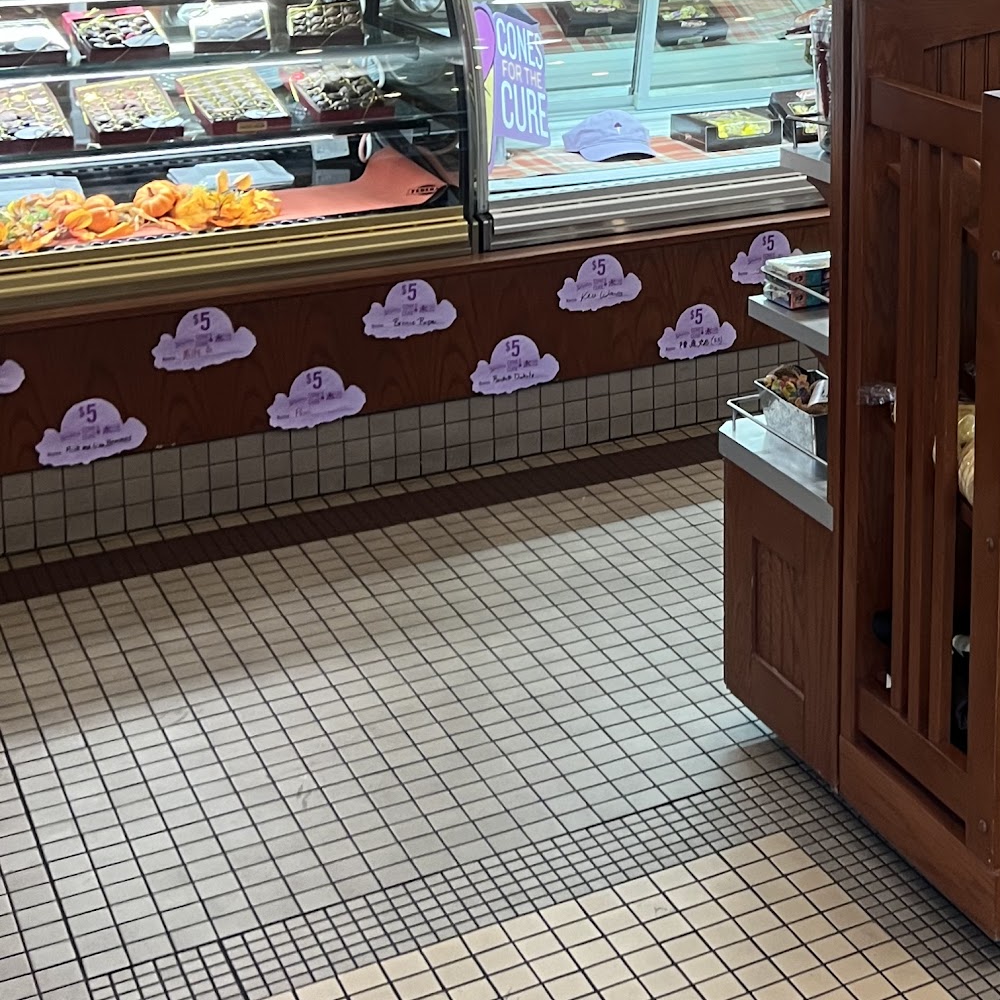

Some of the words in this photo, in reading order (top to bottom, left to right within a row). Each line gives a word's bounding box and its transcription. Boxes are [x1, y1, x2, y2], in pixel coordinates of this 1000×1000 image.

[495, 17, 543, 70] CONES
[502, 60, 523, 83] FOR
[525, 66, 543, 90] THE
[500, 80, 549, 138] CURE
[763, 235, 775, 251] $5
[591, 259, 606, 276] $5
[401, 283, 417, 301] $5
[193, 312, 210, 331] $5
[690, 308, 703, 325] $5
[505, 340, 520, 357] $5
[306, 371, 322, 389] $5
[78, 403, 98, 423] $5
